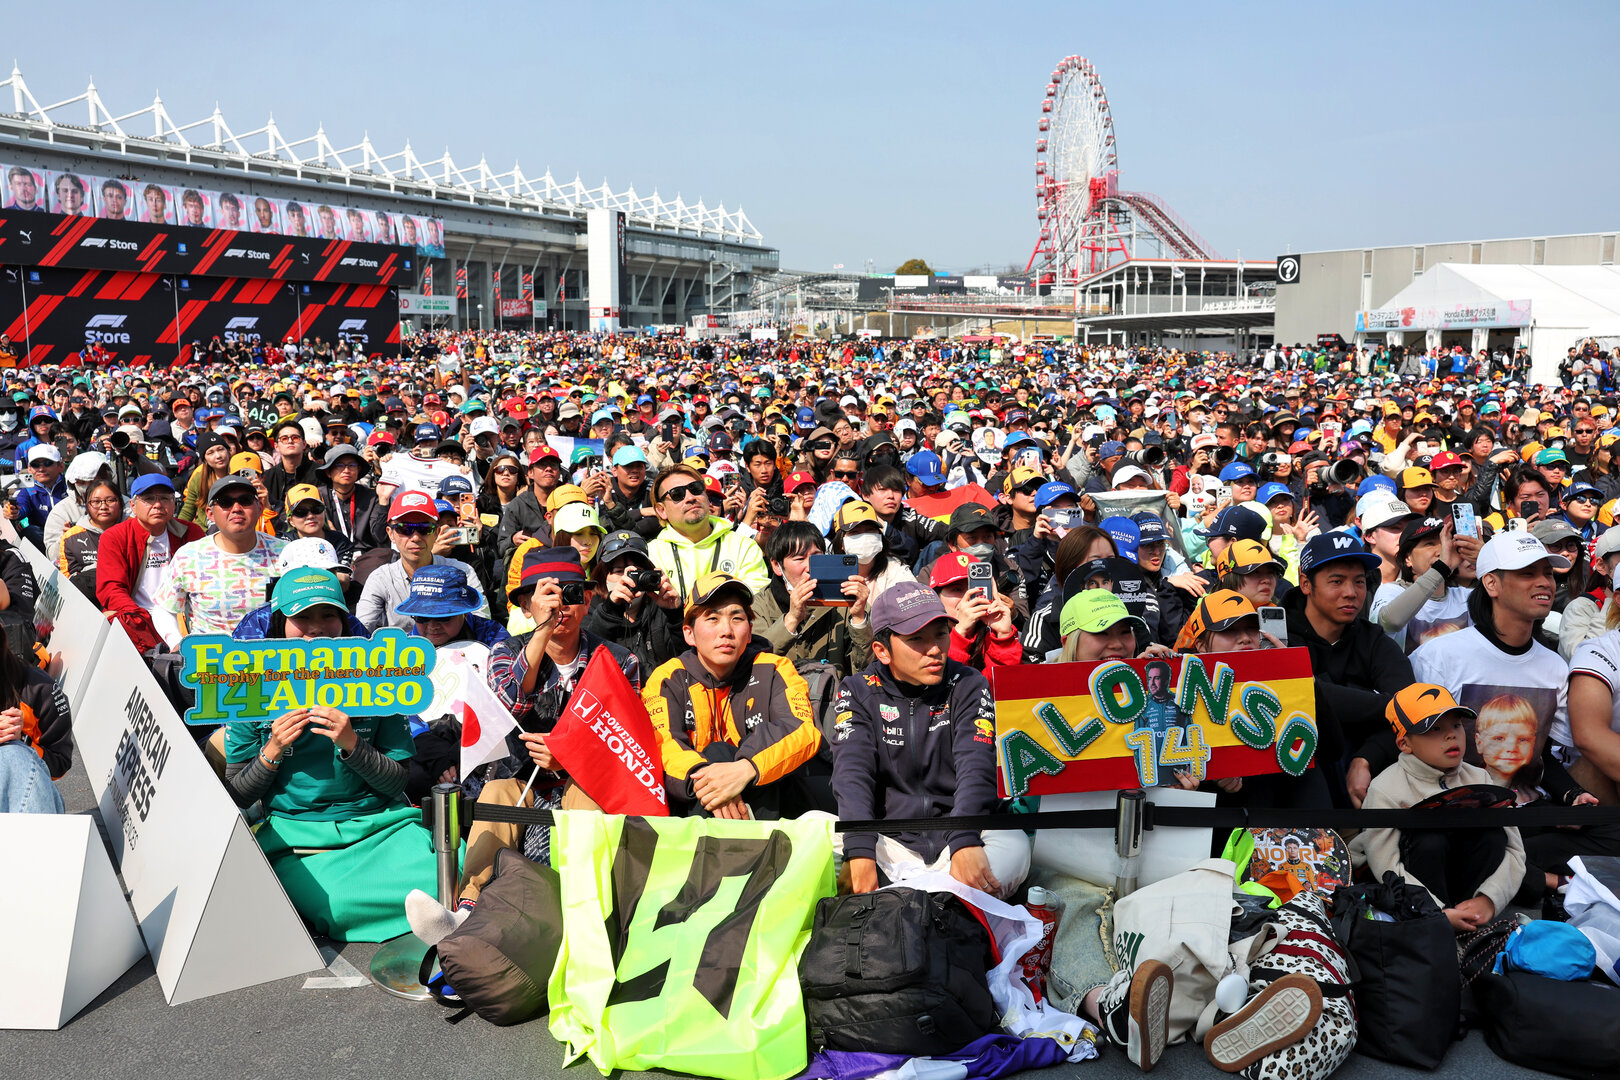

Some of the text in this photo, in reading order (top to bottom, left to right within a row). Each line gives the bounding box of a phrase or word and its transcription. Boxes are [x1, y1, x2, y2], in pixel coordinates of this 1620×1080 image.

[109, 239, 138, 250] Store
[247, 250, 271, 260] Store
[359, 259, 379, 268] Store
[84, 330, 131, 344] Store
[249, 407, 278, 423] ALO
[1110, 530, 1135, 541] WILLIAMS
[1112, 536, 1132, 544] RACING
[1333, 537, 1353, 549] W
[292, 586, 314, 594] FORMULA
[412, 585, 443, 593] Williams
[1114, 592, 1147, 600] ADILLAC
[191, 638, 426, 678] Fernando
[1590, 650, 1617, 671] PIRELLI
[197, 664, 426, 688] Trophy for the hero of race!
[185, 663, 424, 720] 14 Alonso
[881, 711, 899, 720] HEUER
[124, 686, 171, 780] AMERICAN
[1002, 656, 1318, 798] ALONSO
[600, 708, 656, 770] POWERED by
[589, 717, 667, 806] HONDA
[1126, 725, 1211, 787] 14
[115, 729, 156, 822] EXPRESS
